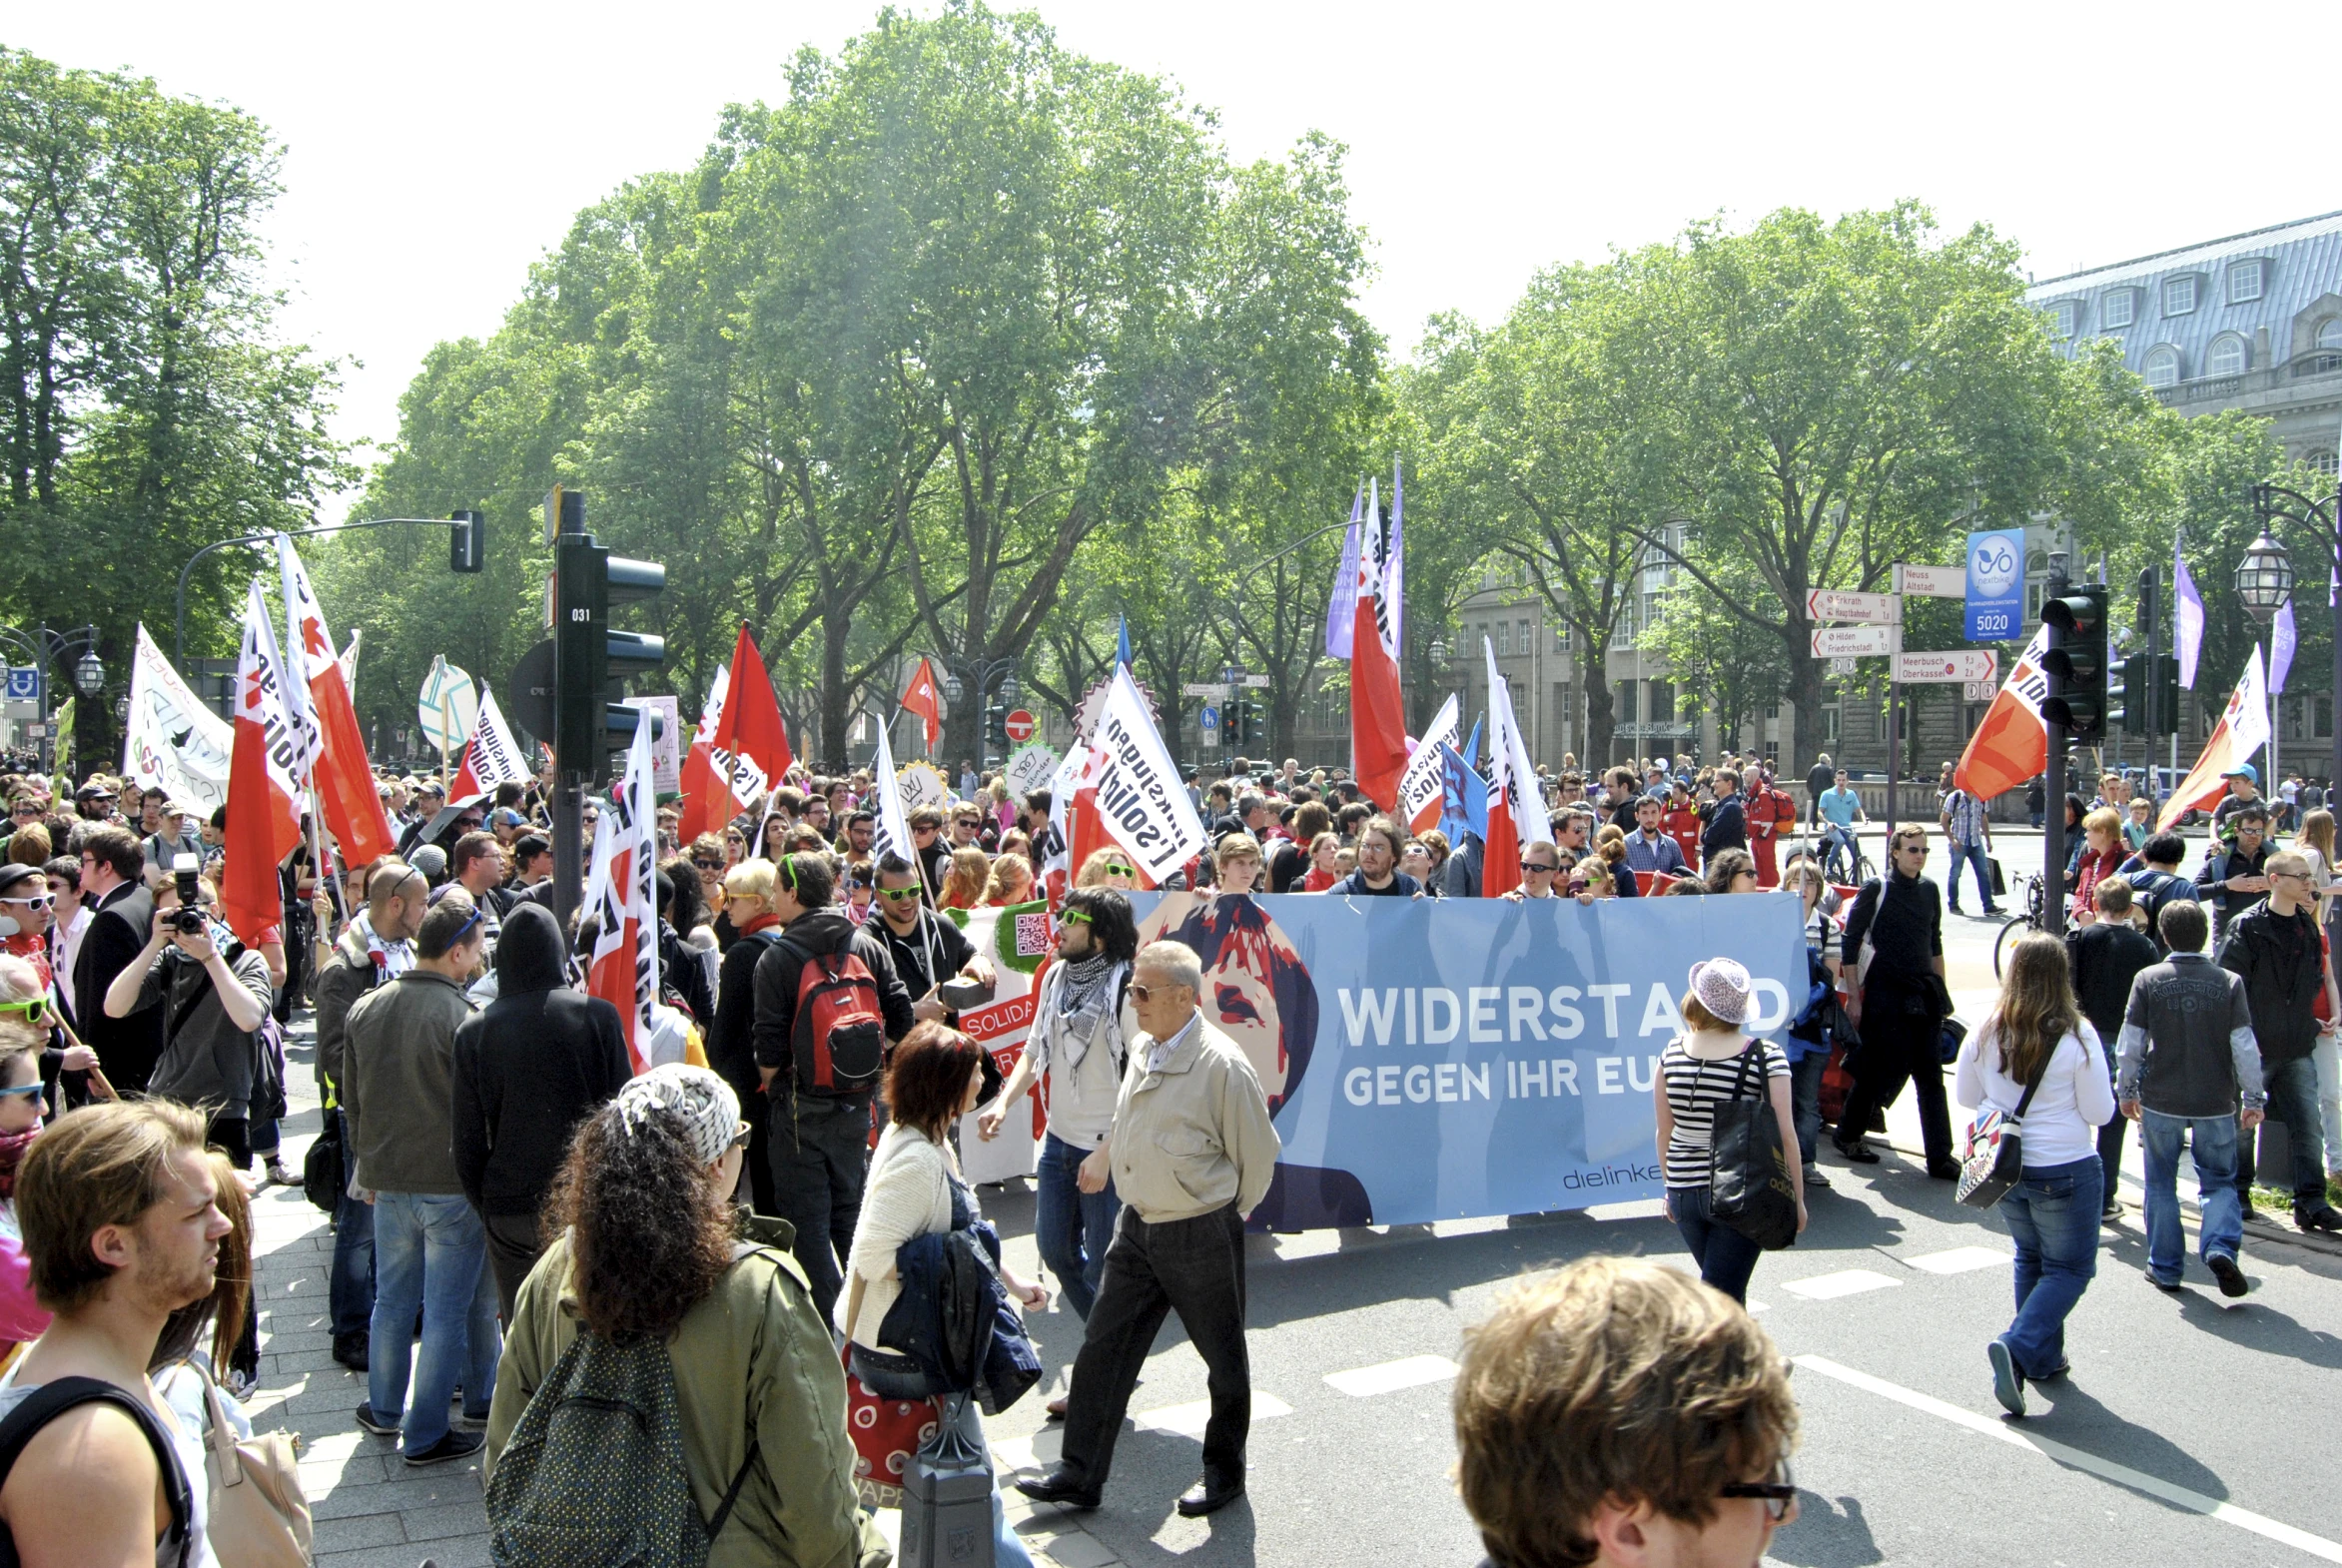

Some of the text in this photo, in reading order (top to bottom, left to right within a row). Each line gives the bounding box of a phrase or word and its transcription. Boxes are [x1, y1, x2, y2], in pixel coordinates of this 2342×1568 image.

[1906, 569, 1930, 579] Neuss
[1977, 575, 2009, 585] nextbike
[1906, 582, 1935, 591] Altstadt
[1836, 595, 1862, 605] Erkrath
[571, 608, 590, 621] 031
[1835, 607, 1872, 619] Hauptbahnhof
[1976, 615, 2008, 630] 5020
[1836, 630, 1885, 641] Hilden 16
[1828, 643, 1873, 653] Friedrichstadt
[1903, 655, 1945, 666] Meerbusch
[1903, 668, 1946, 678] Oberkassel
[2151, 983, 2186, 1000] PORT
[1337, 978, 1790, 1047] WIDERSTAD
[1343, 1062, 1490, 1107] GEGEN
[1508, 1056, 1580, 1100] IHR
[1563, 1164, 1664, 1190] dielinke
[1770, 1177, 1796, 1202] adida
